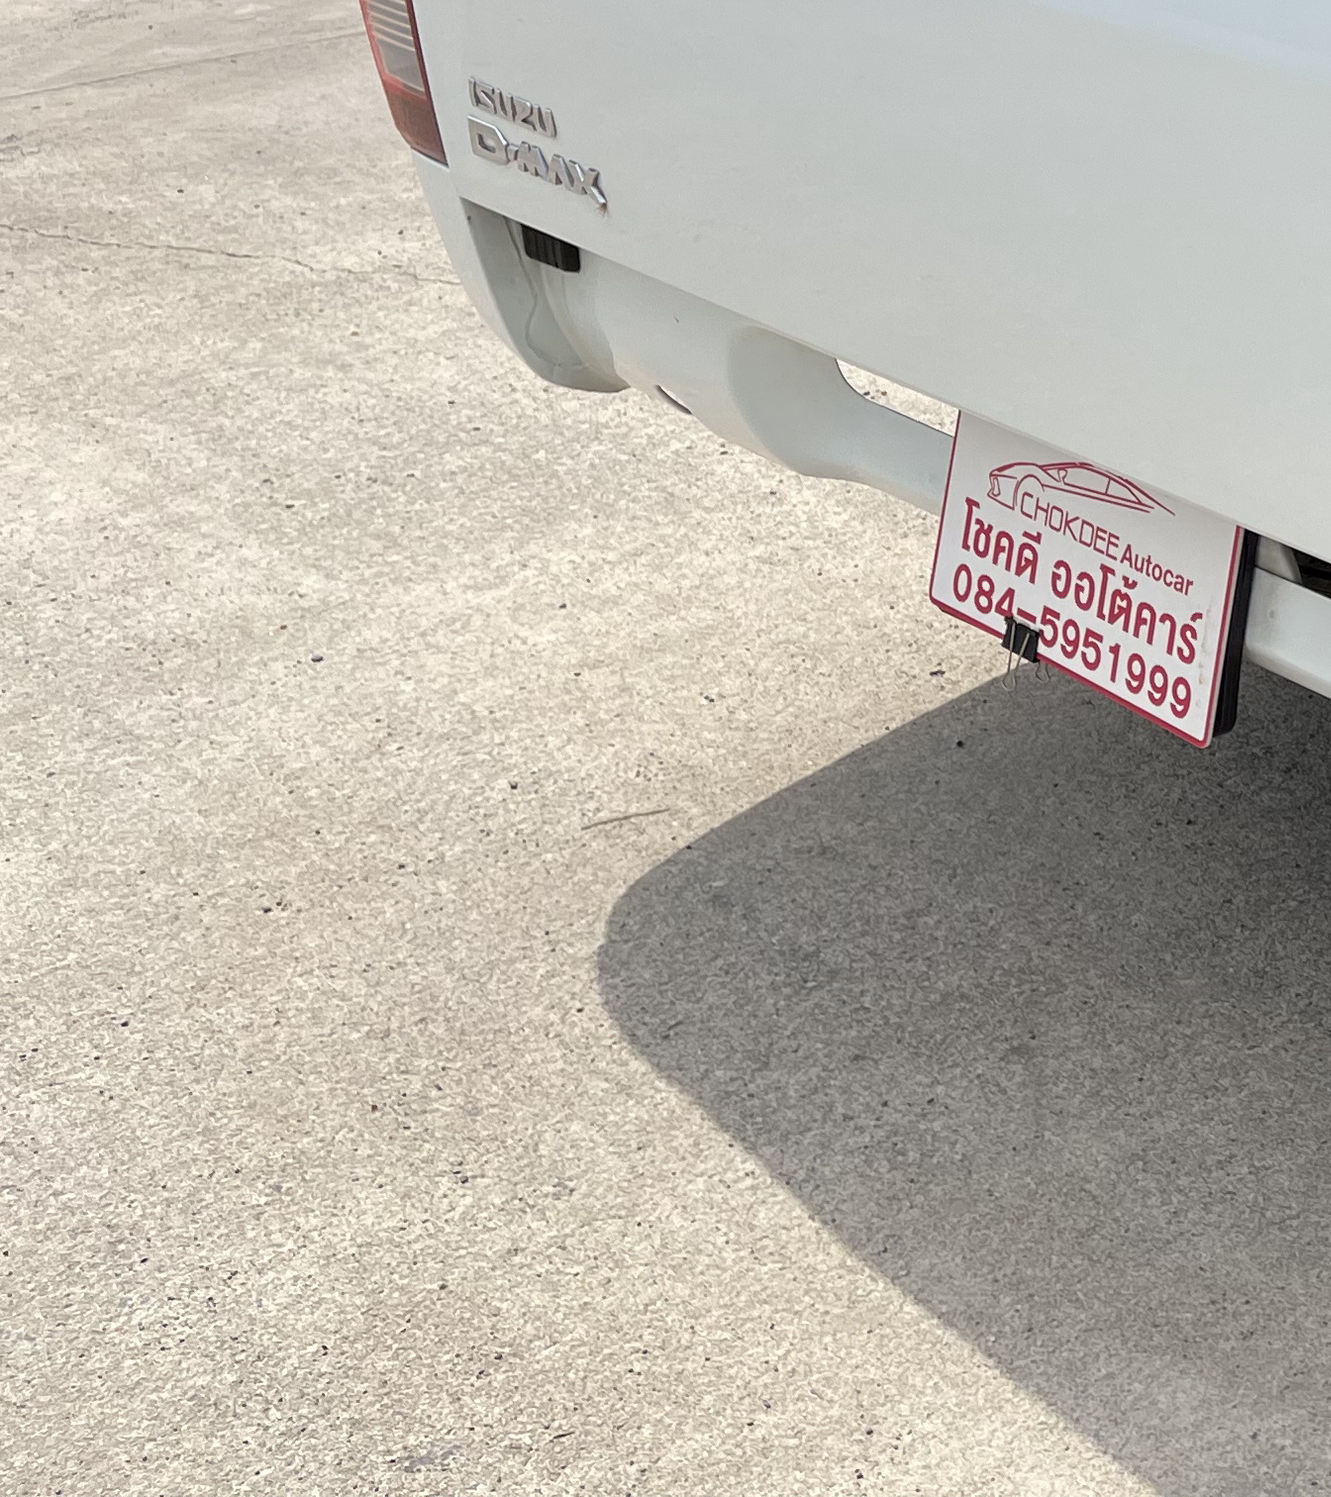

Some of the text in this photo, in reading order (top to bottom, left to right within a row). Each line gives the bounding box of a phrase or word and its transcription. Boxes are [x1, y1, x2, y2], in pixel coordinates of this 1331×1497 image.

[467, 115, 608, 205] D-MAX
[468, 76, 557, 138] ISUZU
[960, 496, 1204, 665] โชคดี ออโต้คาร์
[1019, 491, 1195, 597] CHOKDEE Autocar
[953, 563, 1192, 719] 084-5951999
